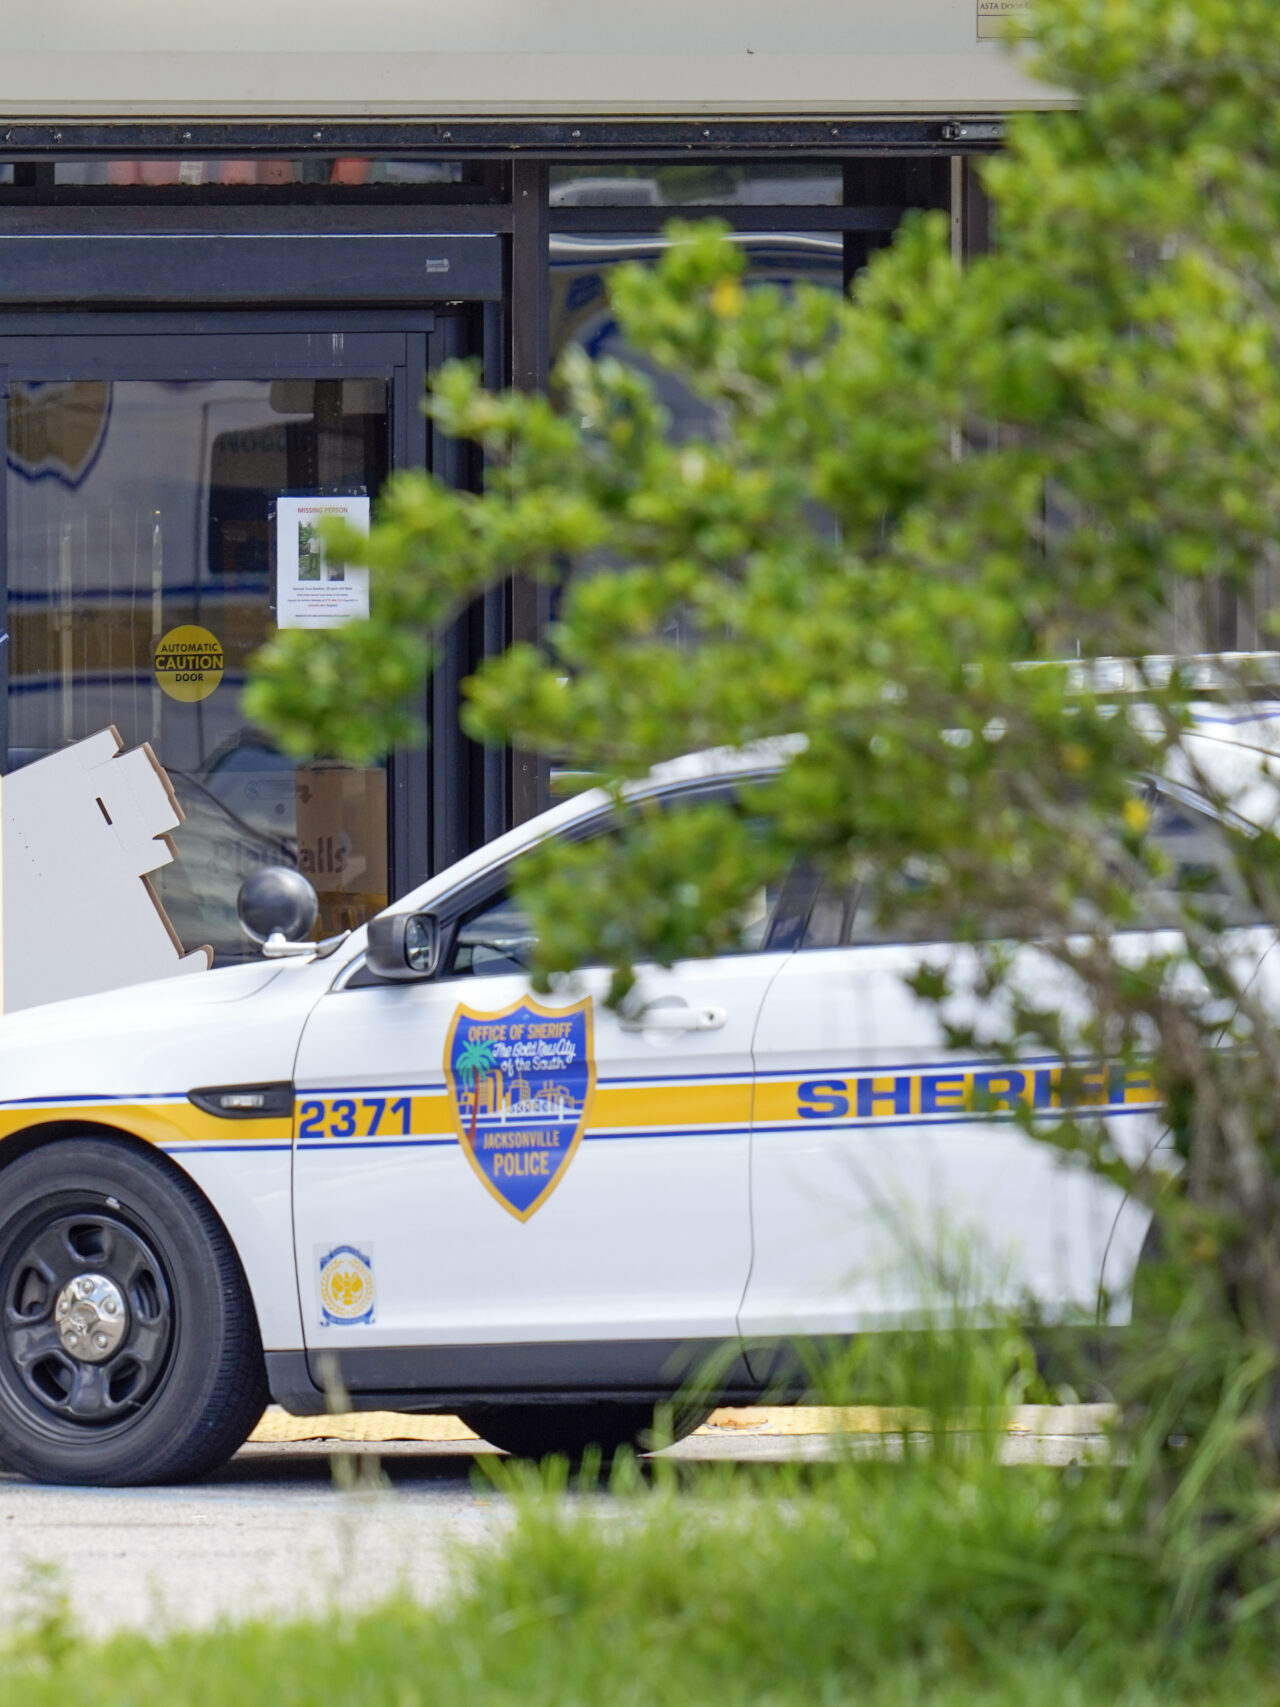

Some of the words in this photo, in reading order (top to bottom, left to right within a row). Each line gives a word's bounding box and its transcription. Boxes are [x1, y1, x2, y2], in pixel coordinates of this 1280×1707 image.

[161, 643, 218, 653] AUTOMATIC
[155, 655, 224, 670] CAUTION
[175, 673, 204, 682] DOOR
[468, 1025, 508, 1042] OFFICE
[509, 1024, 525, 1040] OF
[527, 1022, 573, 1039] SHERIFF
[492, 1042, 512, 1058] The
[500, 1058, 515, 1078] of
[515, 1057, 532, 1072] the
[532, 1056, 567, 1071] South
[299, 1096, 414, 1139] 2371
[483, 1130, 560, 1150] JACKSONVILLE
[493, 1151, 550, 1177] POLICE
